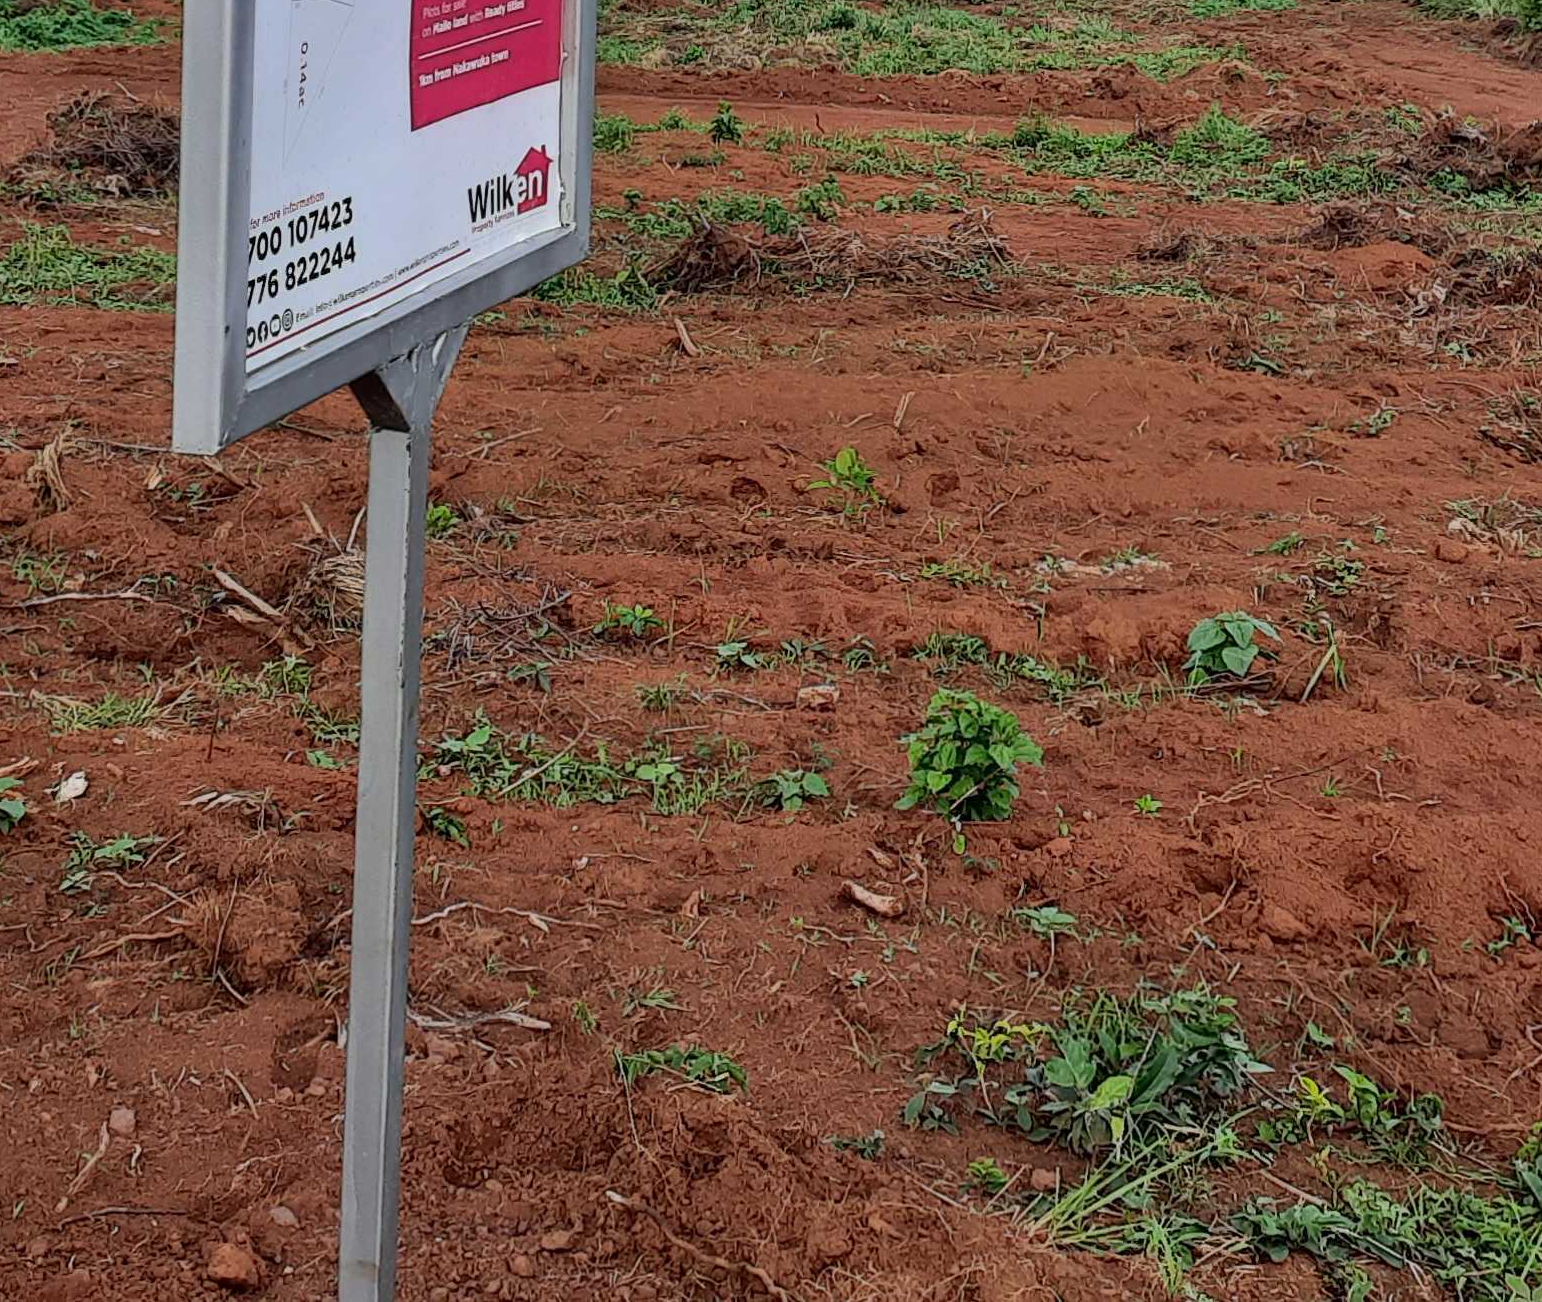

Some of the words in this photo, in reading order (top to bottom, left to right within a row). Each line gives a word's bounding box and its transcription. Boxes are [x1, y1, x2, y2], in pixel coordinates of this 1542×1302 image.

[288, 196, 353, 247] 107423
[467, 170, 543, 223] Wilken
[285, 236, 356, 291] 822244
